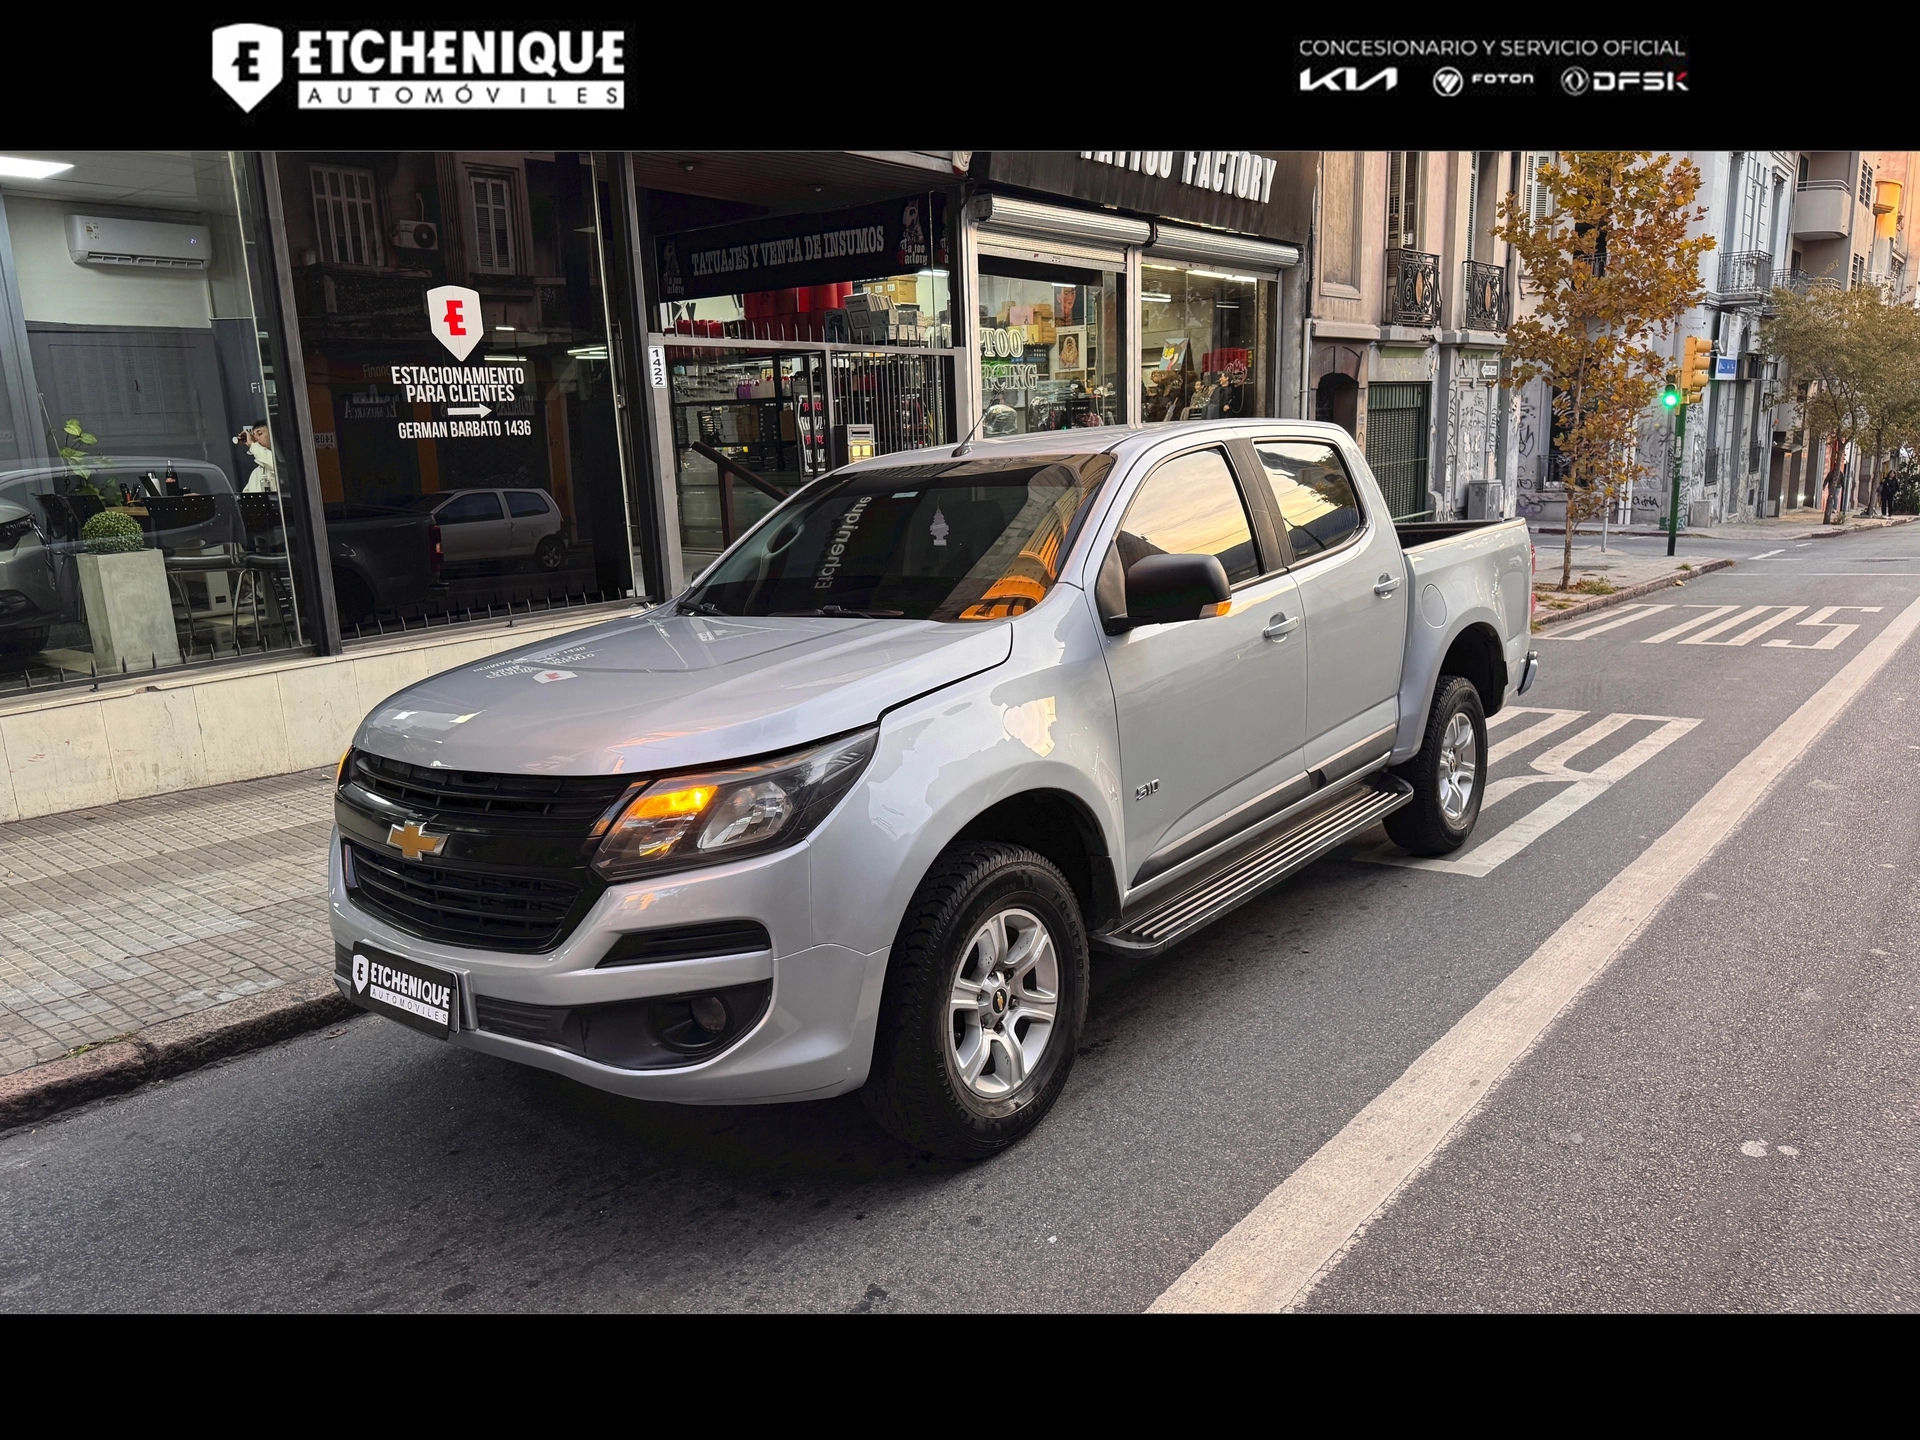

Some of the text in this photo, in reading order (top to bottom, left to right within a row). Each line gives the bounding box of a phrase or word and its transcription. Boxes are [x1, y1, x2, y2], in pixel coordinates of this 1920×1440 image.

[1181, 151, 1277, 204] FACTORY
[692, 225, 884, 276] TATUAJES Y VENTA DE INSUMOS
[391, 366, 525, 385] ESTACIONAMIENTO
[651, 347, 664, 386] 1422
[406, 384, 515, 404] PARA CLIENTES
[398, 420, 532, 440] GERMAN BARBATO 1436
[1135, 779, 1160, 801] S10
[370, 962, 451, 1009] ETCHENIQUE
[371, 988, 447, 1023] AUTOMÓVILES
